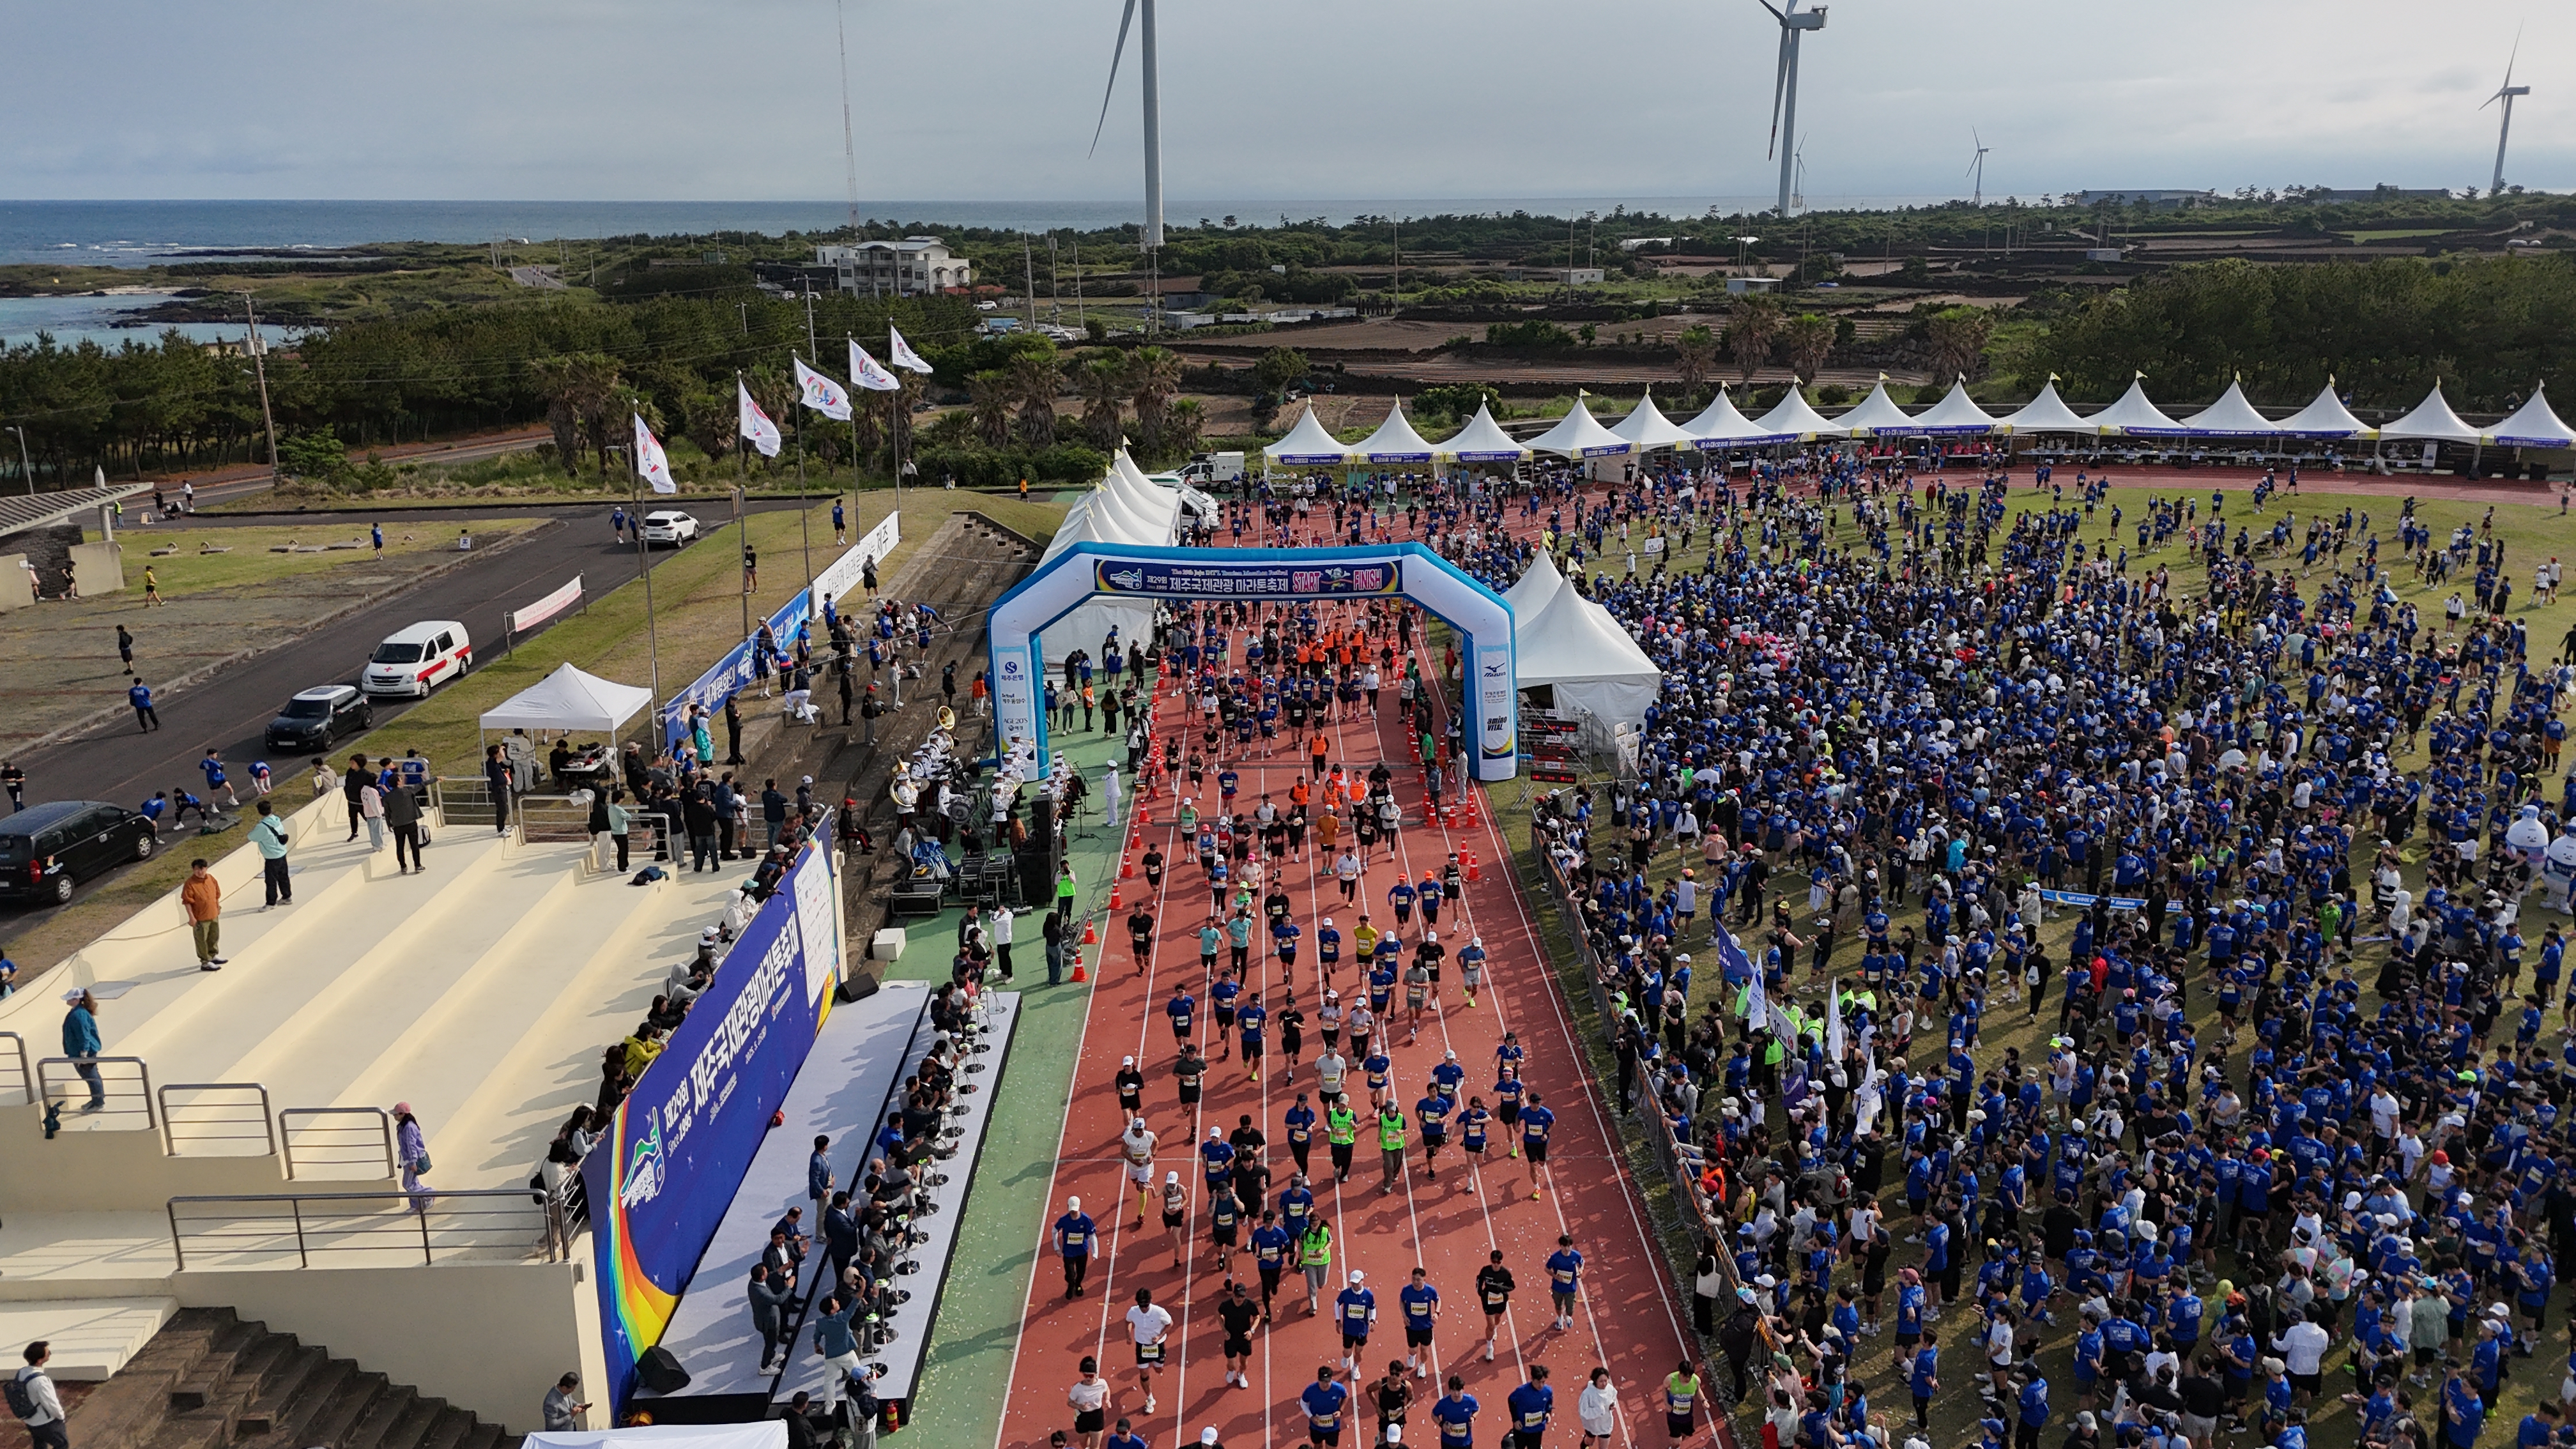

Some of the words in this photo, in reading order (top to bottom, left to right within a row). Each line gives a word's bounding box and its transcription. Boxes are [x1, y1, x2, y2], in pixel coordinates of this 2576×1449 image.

[1147, 576, 1168, 584] 제29회
[1169, 578, 1234, 593] 제주국제관광
[1236, 578, 1289, 592] 마라톤축제
[1292, 571, 1321, 592] START
[1353, 569, 1382, 591] FINISH
[1487, 715, 1507, 725] amino
[1487, 723, 1504, 732] VITAL
[664, 1077, 690, 1133] 제29회
[678, 1108, 693, 1142] 1995
